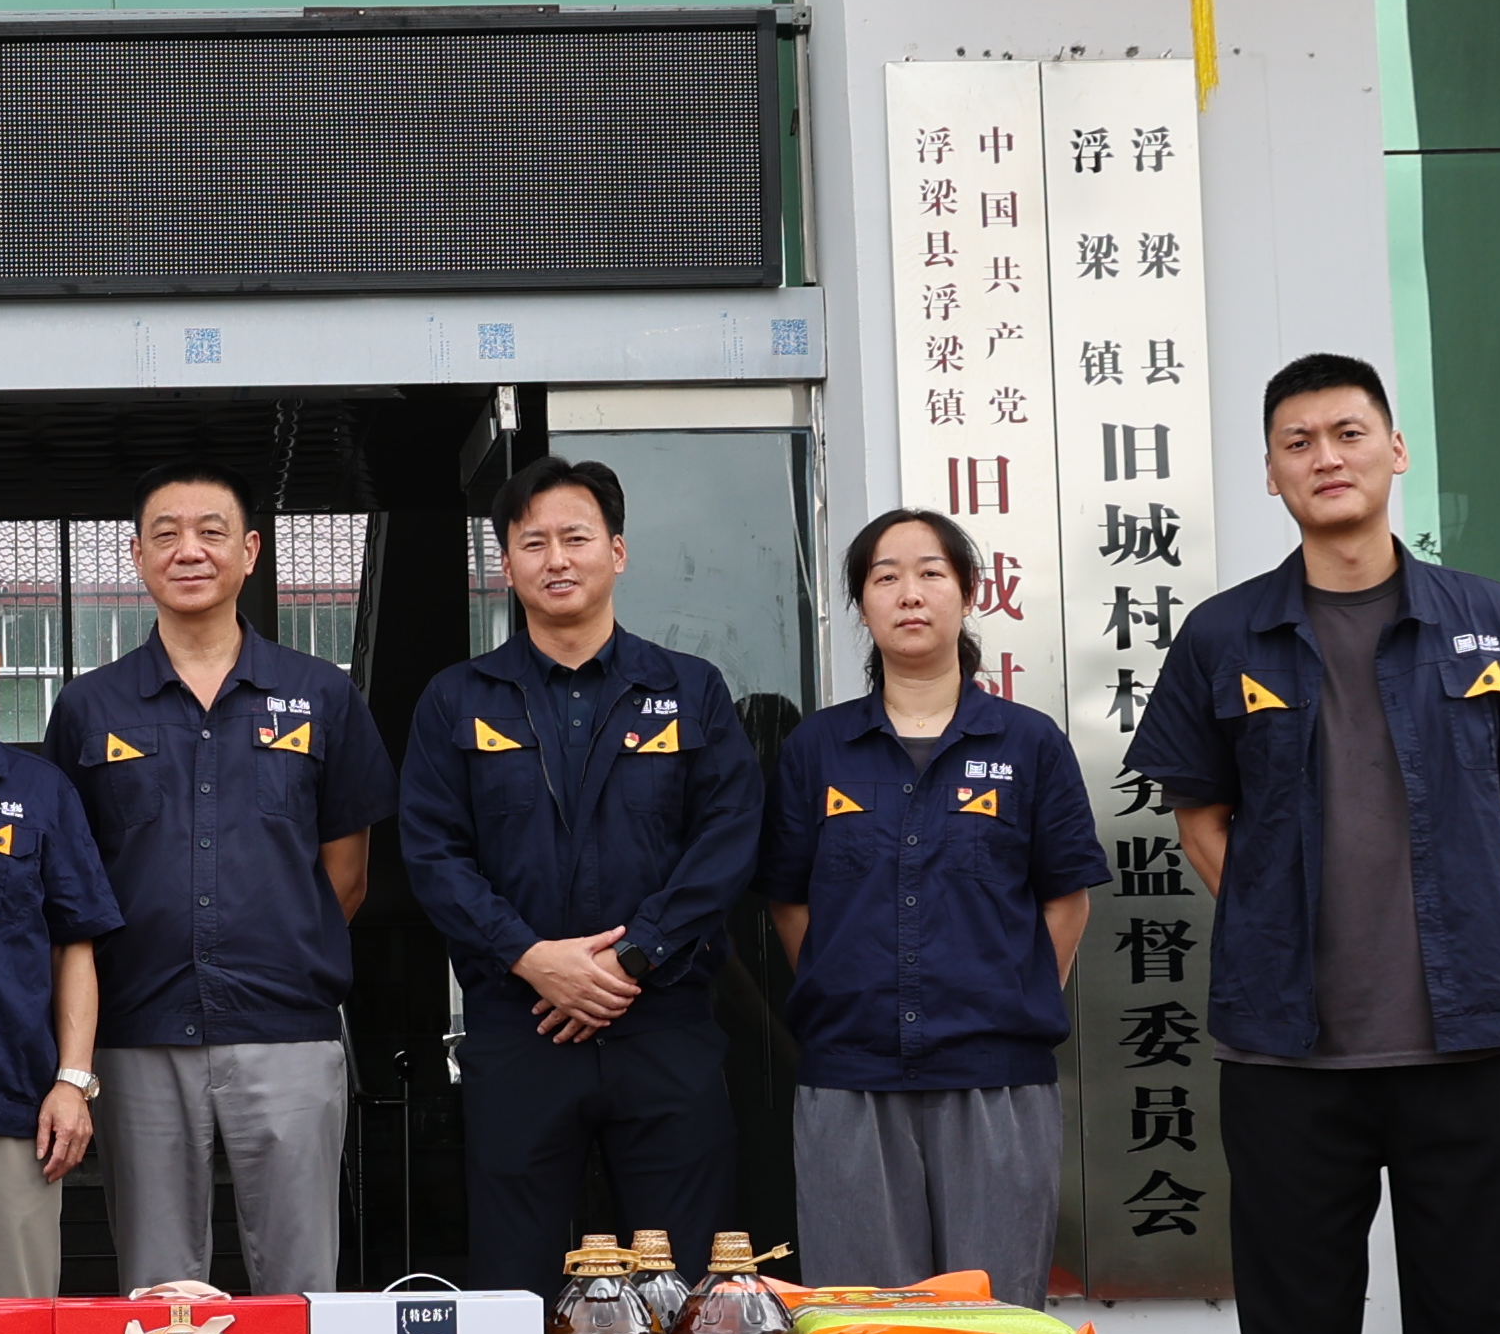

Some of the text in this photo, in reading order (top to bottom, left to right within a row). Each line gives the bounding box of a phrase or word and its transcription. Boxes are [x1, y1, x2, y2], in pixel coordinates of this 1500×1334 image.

[915, 127, 966, 426] 浮梁县浮梁镇
[980, 126, 1028, 425] 中国共产党
[1070, 128, 1123, 387] 浮梁镇
[1132, 126, 1184, 385] 浮梁县
[410, 1308, 443, 1323] 特仑苏
